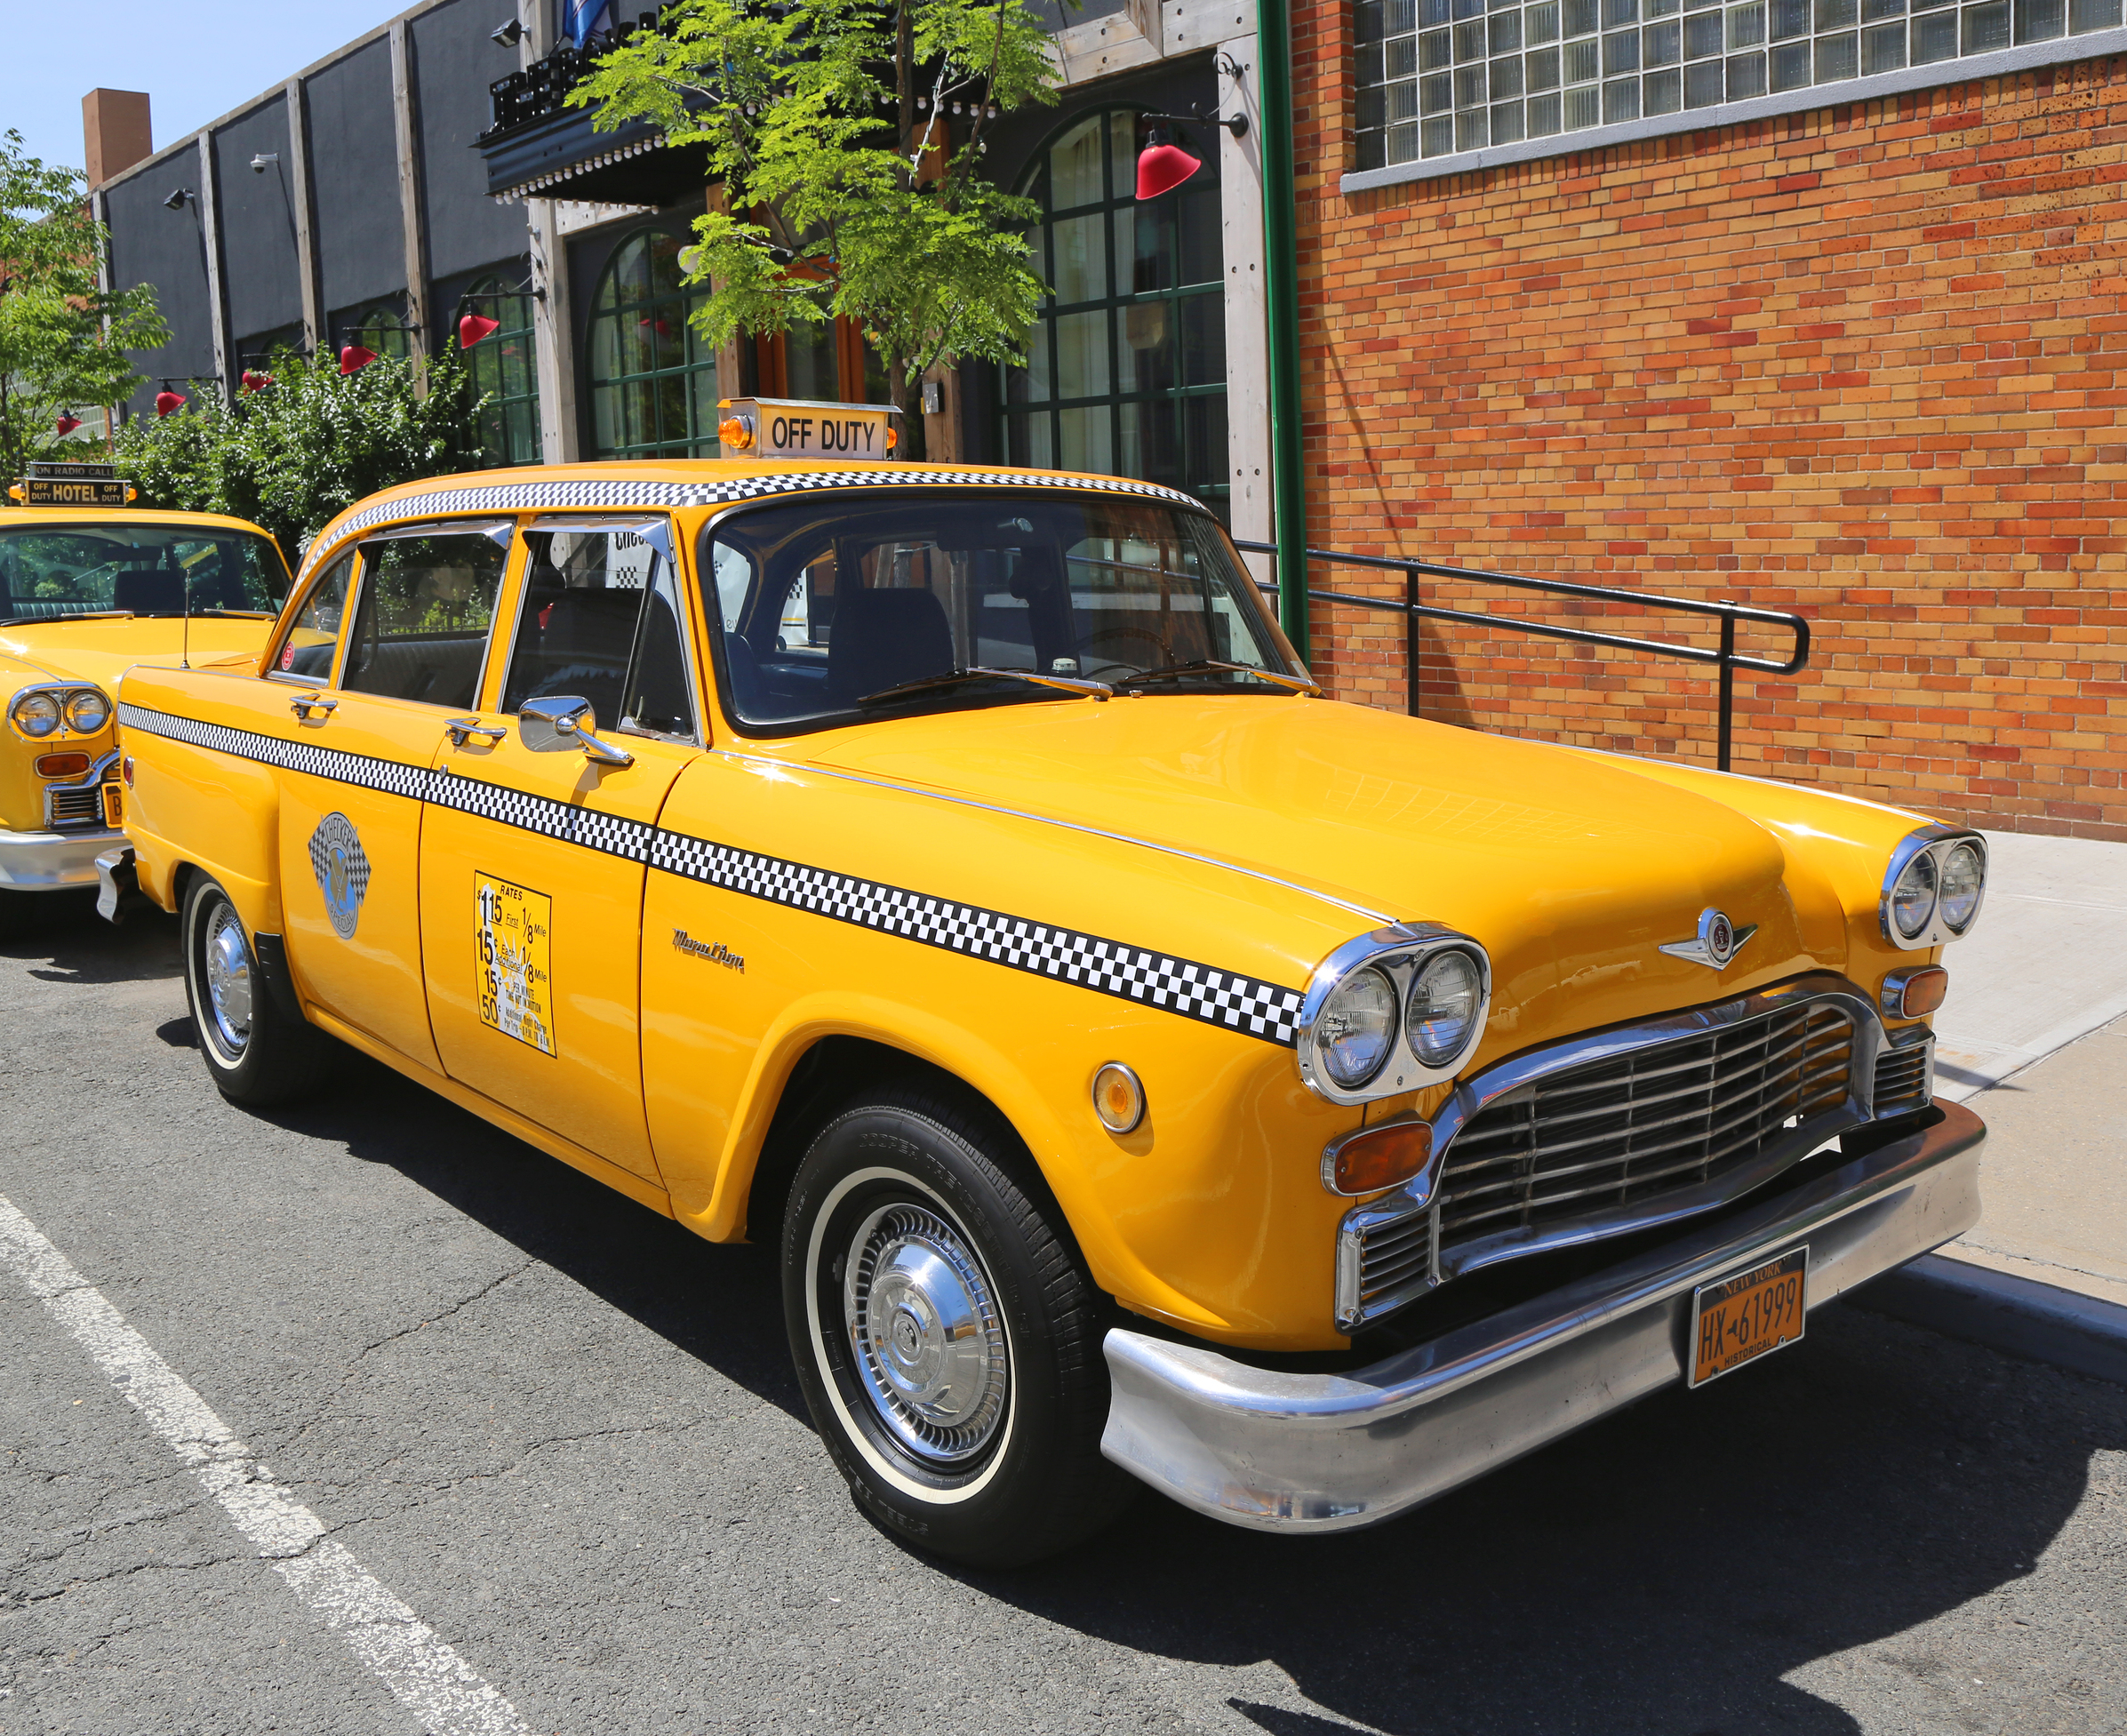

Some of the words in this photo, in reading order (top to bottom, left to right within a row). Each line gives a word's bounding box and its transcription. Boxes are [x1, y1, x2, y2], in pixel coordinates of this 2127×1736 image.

[772, 416, 812, 449] OFF
[822, 420, 876, 452] DUTY
[36, 466, 51, 475] ON
[54, 467, 85, 476] RADIO
[88, 468, 112, 476] CALL
[31, 492, 52, 500] DUTY
[33, 483, 49, 491] OFF
[53, 484, 99, 501] HOTEL
[103, 484, 118, 492] OFF
[101, 494, 121, 502] DUTY
[324, 817, 353, 852] CHECKER
[500, 884, 523, 900] RATES
[506, 913, 519, 926] First
[534, 924, 547, 937] Mile
[495, 953, 523, 972] Additional
[501, 944, 516, 958] Each
[534, 969, 548, 982] Mile
[859, 1132, 920, 1161] COOPER
[926, 1153, 1021, 1304] TRENDSETTER
[1724, 1275, 1753, 1298] NEW
[1754, 1260, 1782, 1283] YORK
[1700, 1308, 1727, 1364] HX
[1739, 1276, 1796, 1346] 61999
[1723, 1337, 1772, 1367] HISTORICAL
